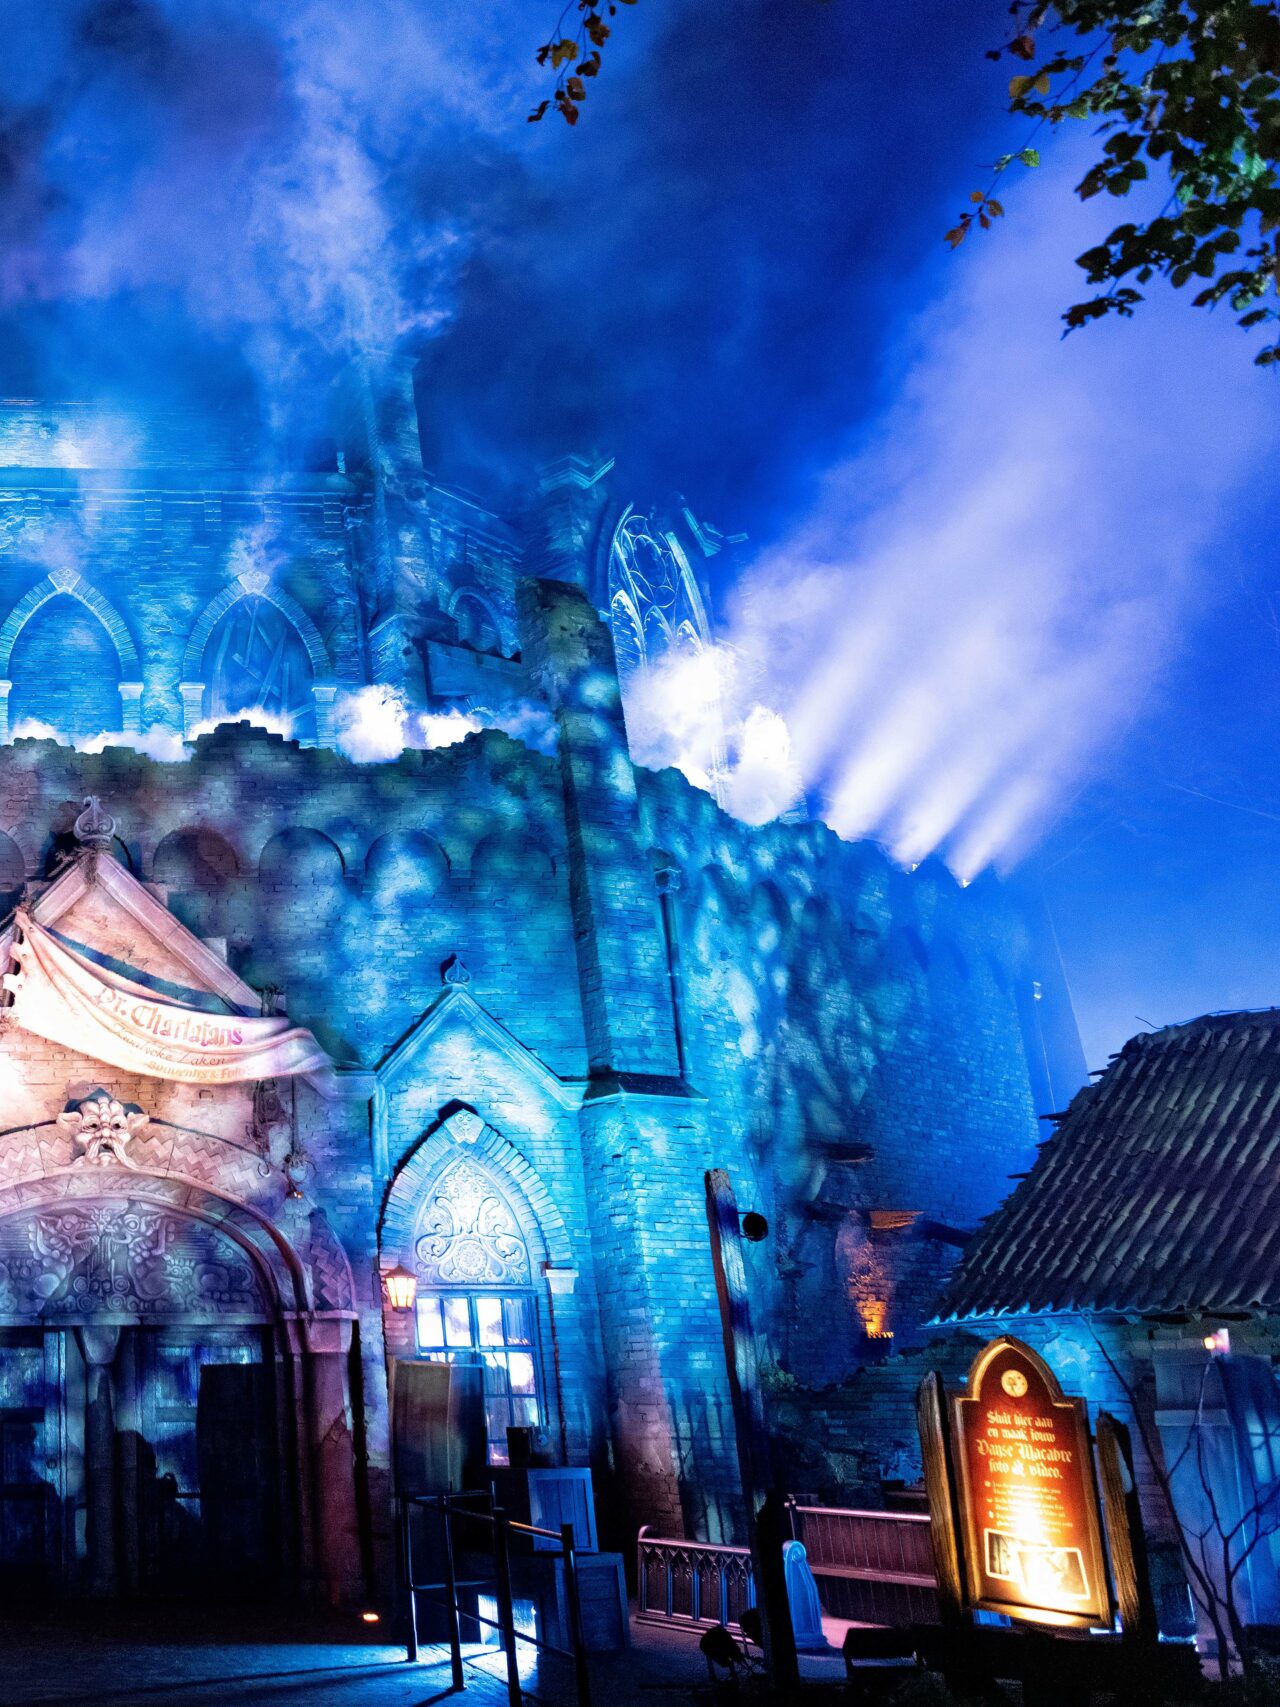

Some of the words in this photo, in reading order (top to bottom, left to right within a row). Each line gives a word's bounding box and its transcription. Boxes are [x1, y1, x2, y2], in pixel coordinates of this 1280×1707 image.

[95, 987, 127, 1016] Dr.
[130, 1005, 243, 1047] Charlatans
[987, 1410, 1012, 1425] Sluit
[1014, 1411, 1033, 1427] hier
[1035, 1417, 1054, 1428] aan
[987, 1427, 999, 1438] en
[1001, 1427, 1028, 1441] maak
[1030, 1428, 1056, 1442] jouw
[976, 1439, 1013, 1458] Danse
[1015, 1441, 1072, 1463] Macabre
[988, 1459, 1009, 1474] foto
[1011, 1459, 1026, 1477] &
[1028, 1461, 1064, 1479] video.
